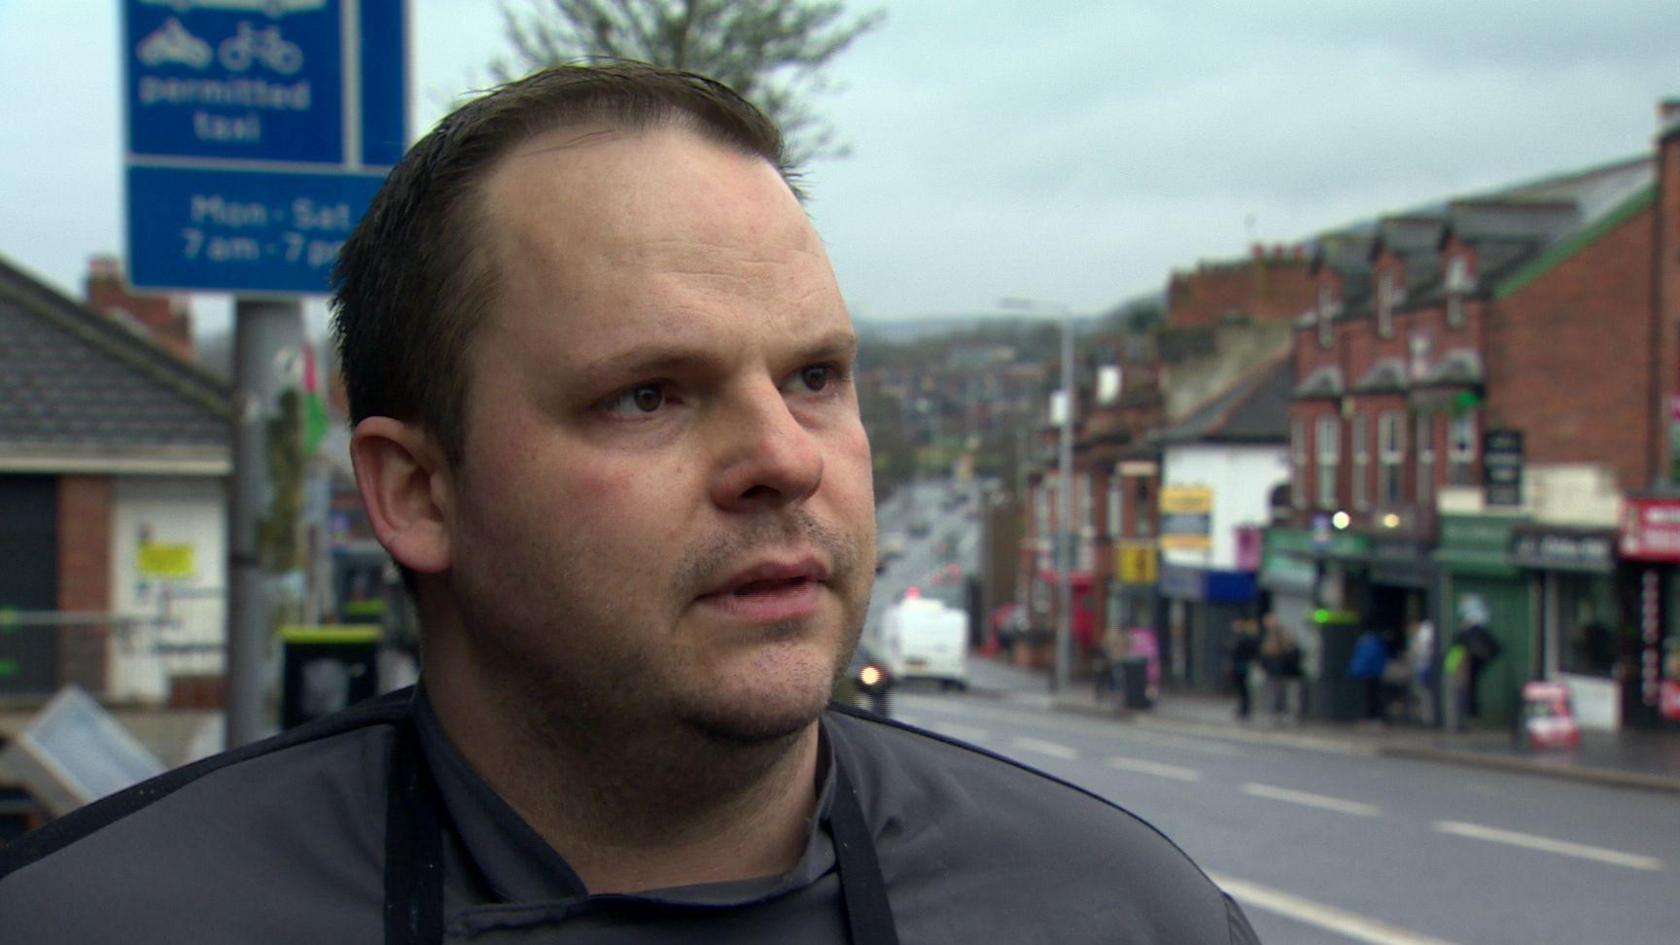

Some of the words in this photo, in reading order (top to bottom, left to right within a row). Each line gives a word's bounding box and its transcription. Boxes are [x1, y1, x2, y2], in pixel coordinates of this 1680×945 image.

[140, 78, 311, 110] permitted
[194, 111, 260, 141] taxi
[191, 194, 268, 226] Mon
[292, 198, 350, 230] Sat
